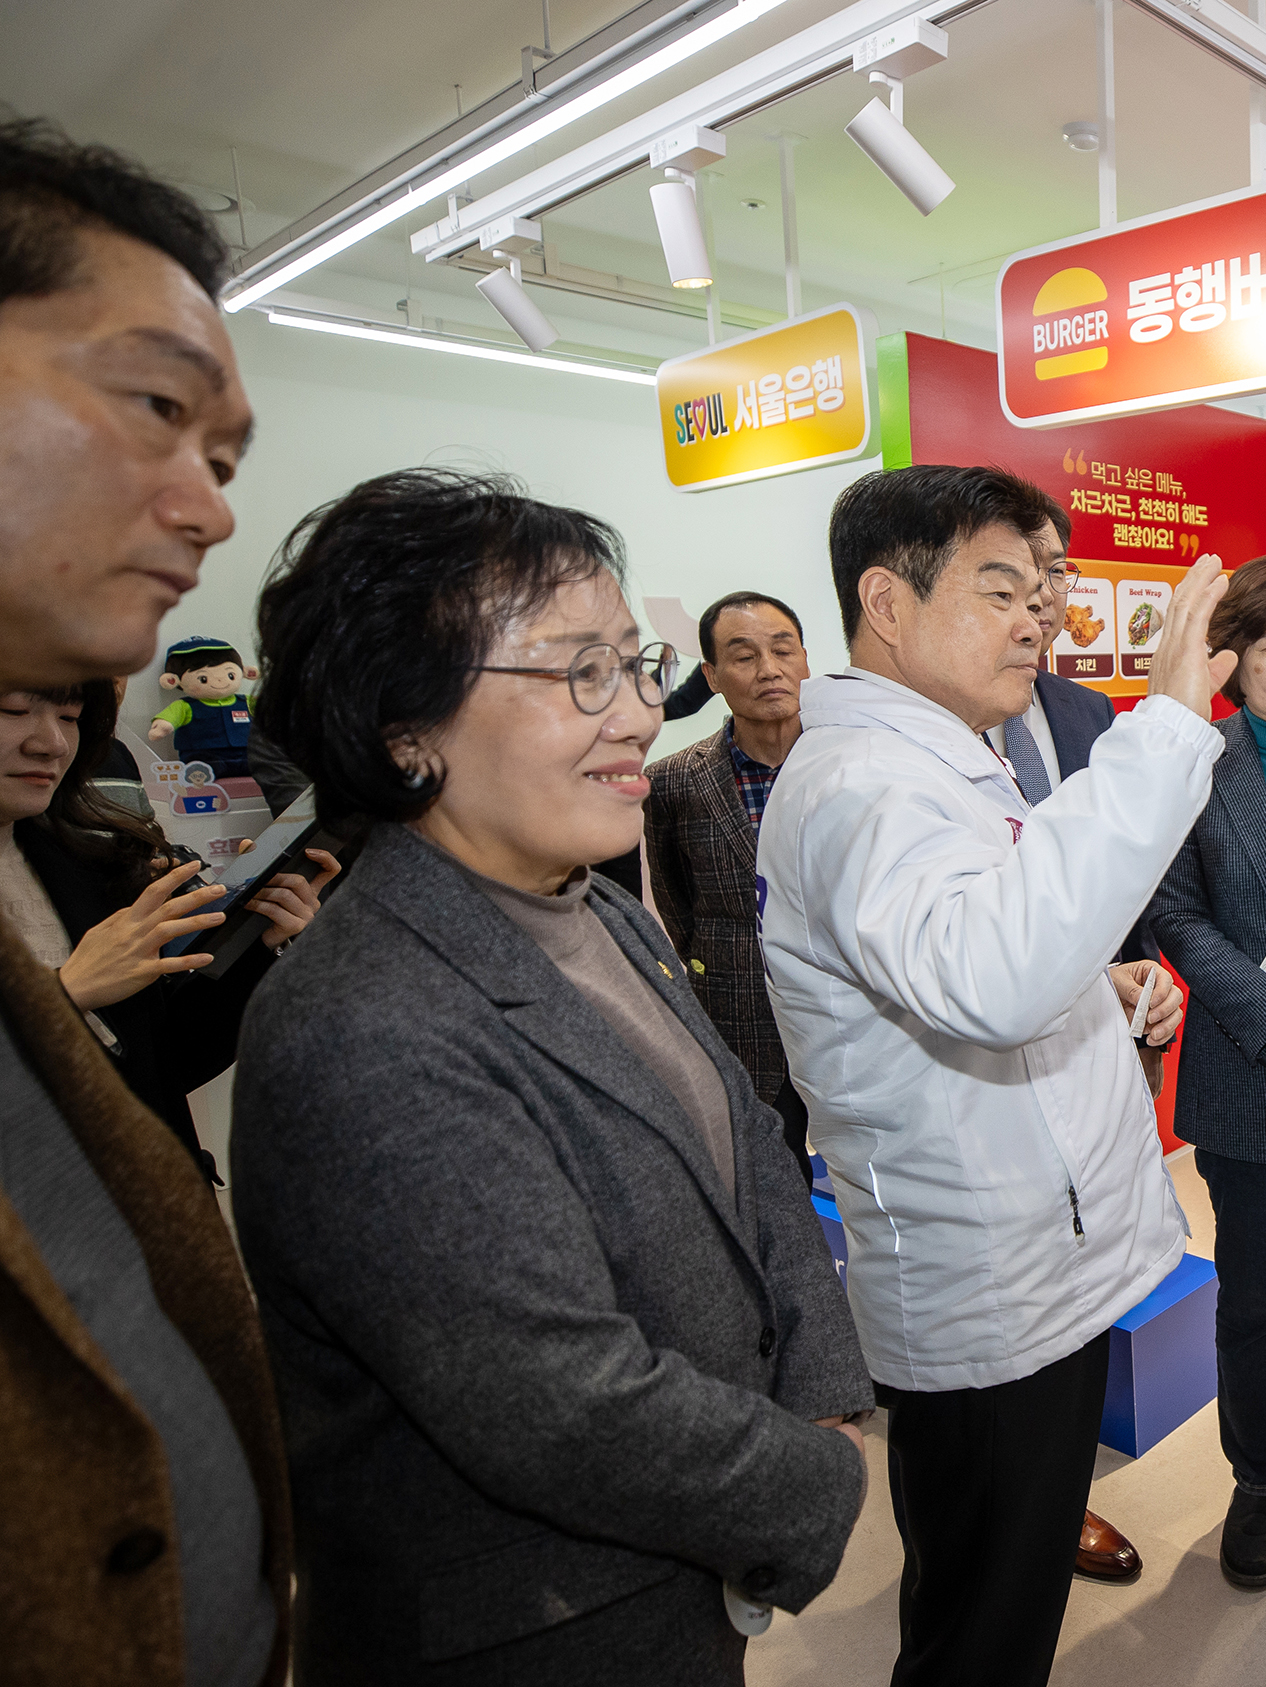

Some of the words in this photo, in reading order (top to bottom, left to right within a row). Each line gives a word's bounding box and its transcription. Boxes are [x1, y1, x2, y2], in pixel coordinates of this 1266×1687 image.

[1033, 309, 1109, 353] BURGER
[734, 355, 846, 432] 서울은행
[1091, 461, 1122, 486] 먹고
[1124, 467, 1153, 491] 싶은
[1156, 472, 1187, 499] 메뉴,
[1070, 488, 1136, 521] 차근차근,
[1139, 497, 1180, 523] 천천히
[1182, 503, 1208, 526] 해도
[1113, 523, 1174, 549] 괜찮아요!
[1129, 588, 1143, 596] Beef
[1145, 589, 1162, 598] Wrap
[1075, 658, 1097, 672] 치킨
